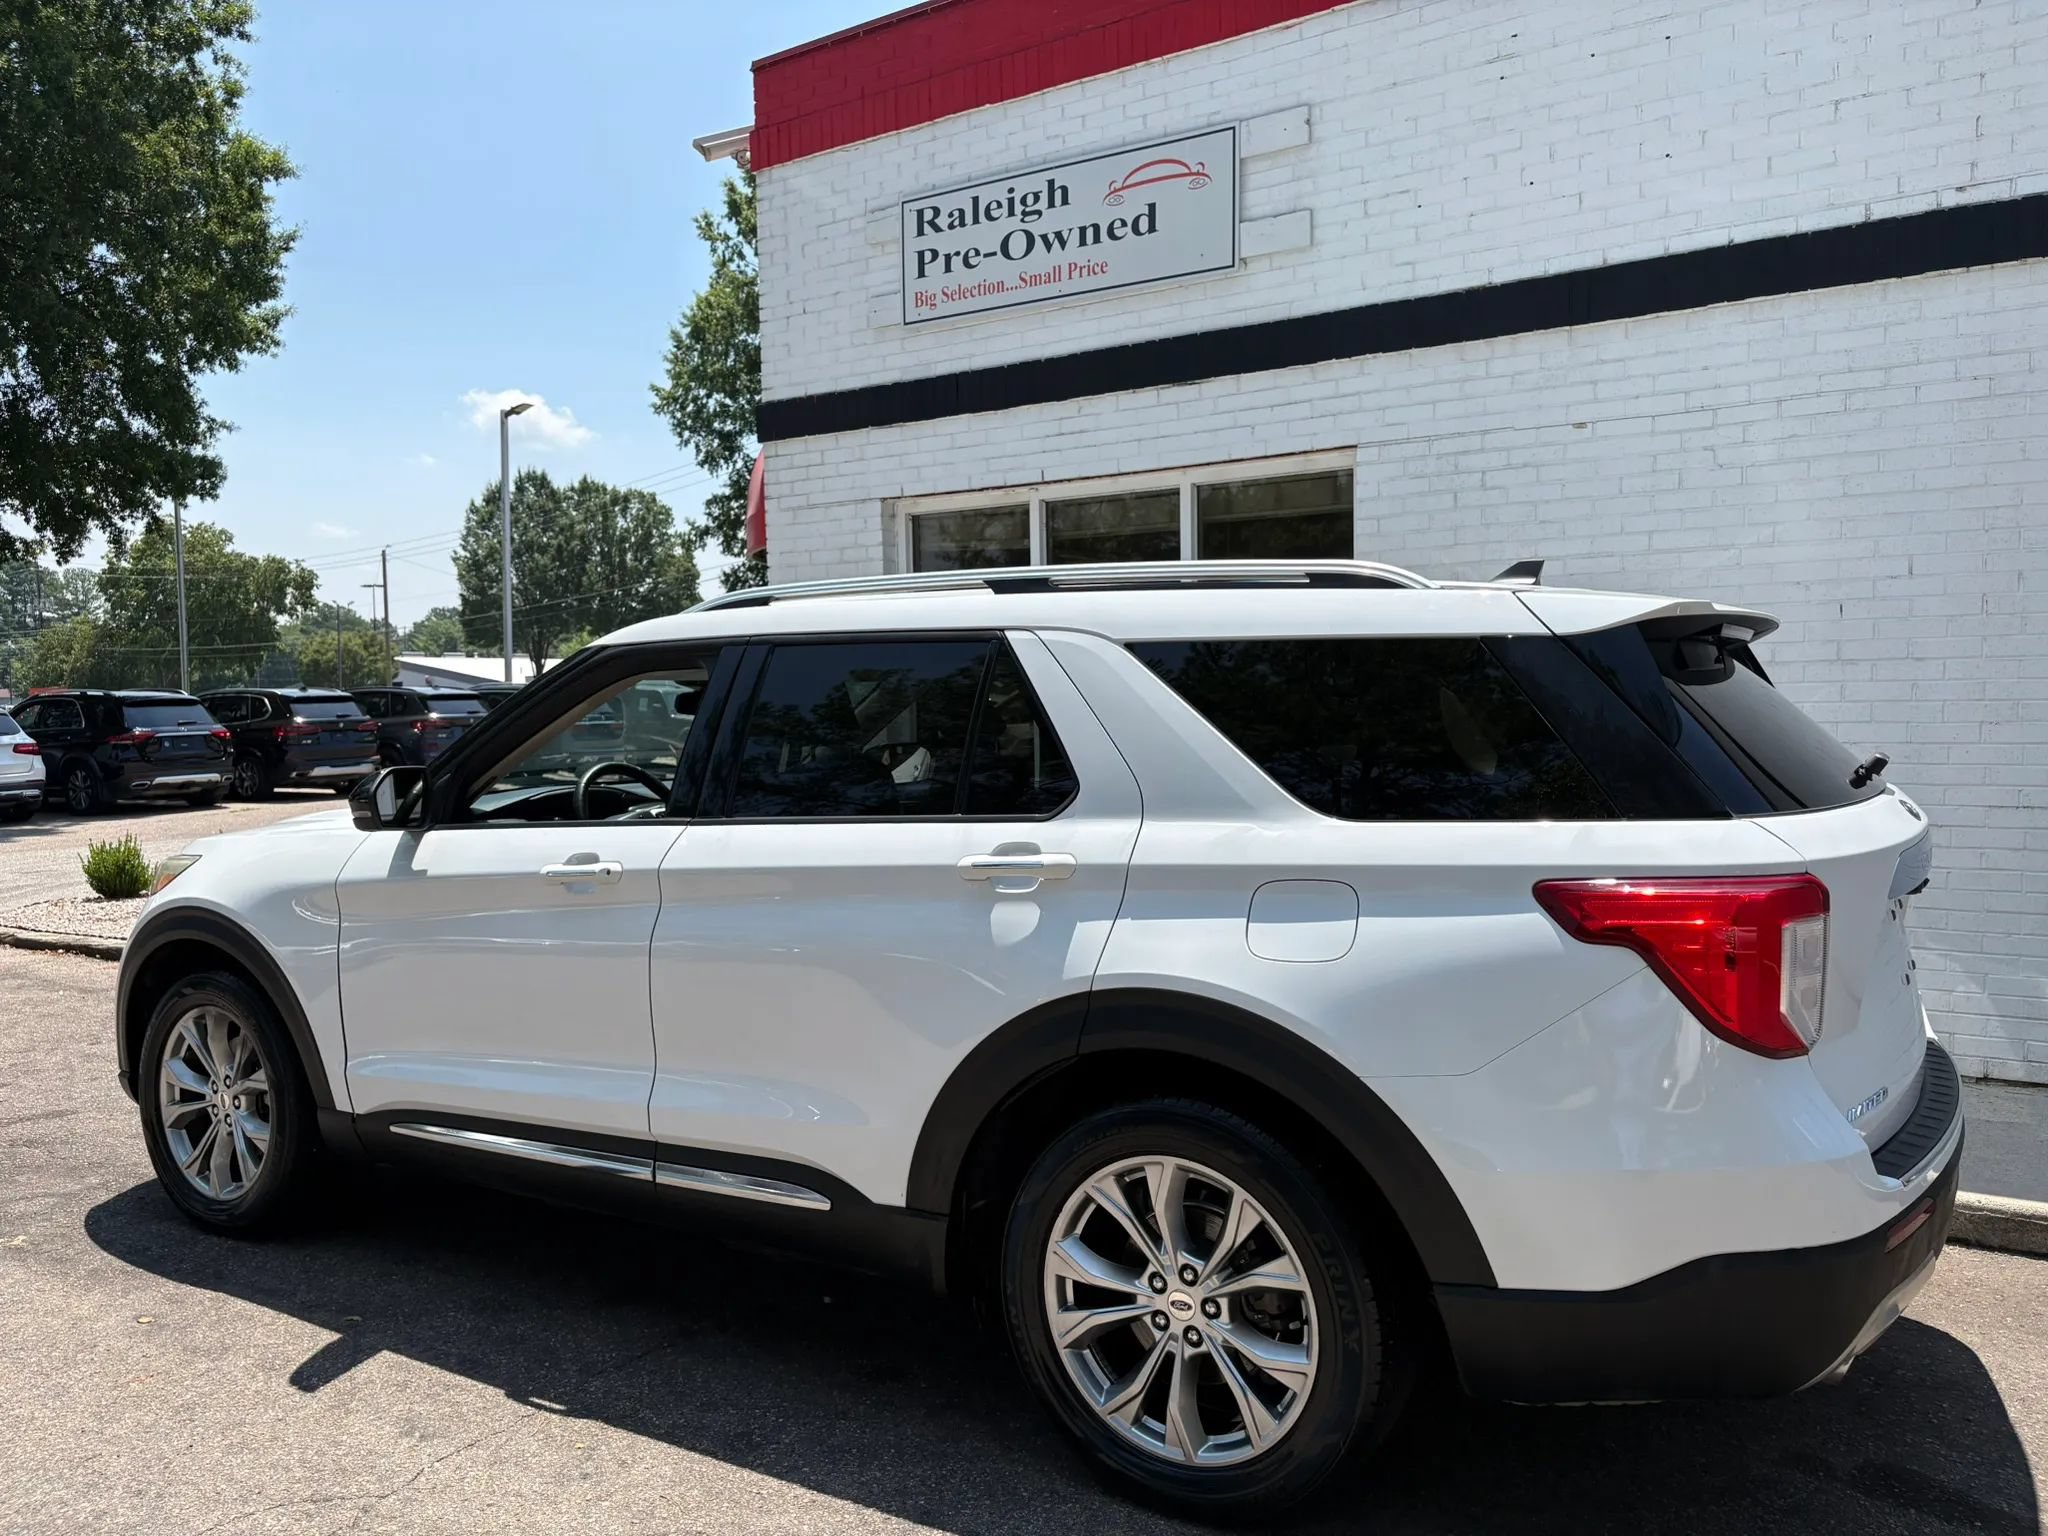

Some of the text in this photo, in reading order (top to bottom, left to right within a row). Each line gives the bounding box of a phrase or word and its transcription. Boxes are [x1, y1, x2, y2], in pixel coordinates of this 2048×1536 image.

[913, 178, 1071, 238] Raleigh
[914, 202, 1159, 280] Pre-Owned
[915, 291, 937, 310] Big
[1068, 259, 1109, 281] Price
[1847, 1087, 1888, 1122] IMITED
